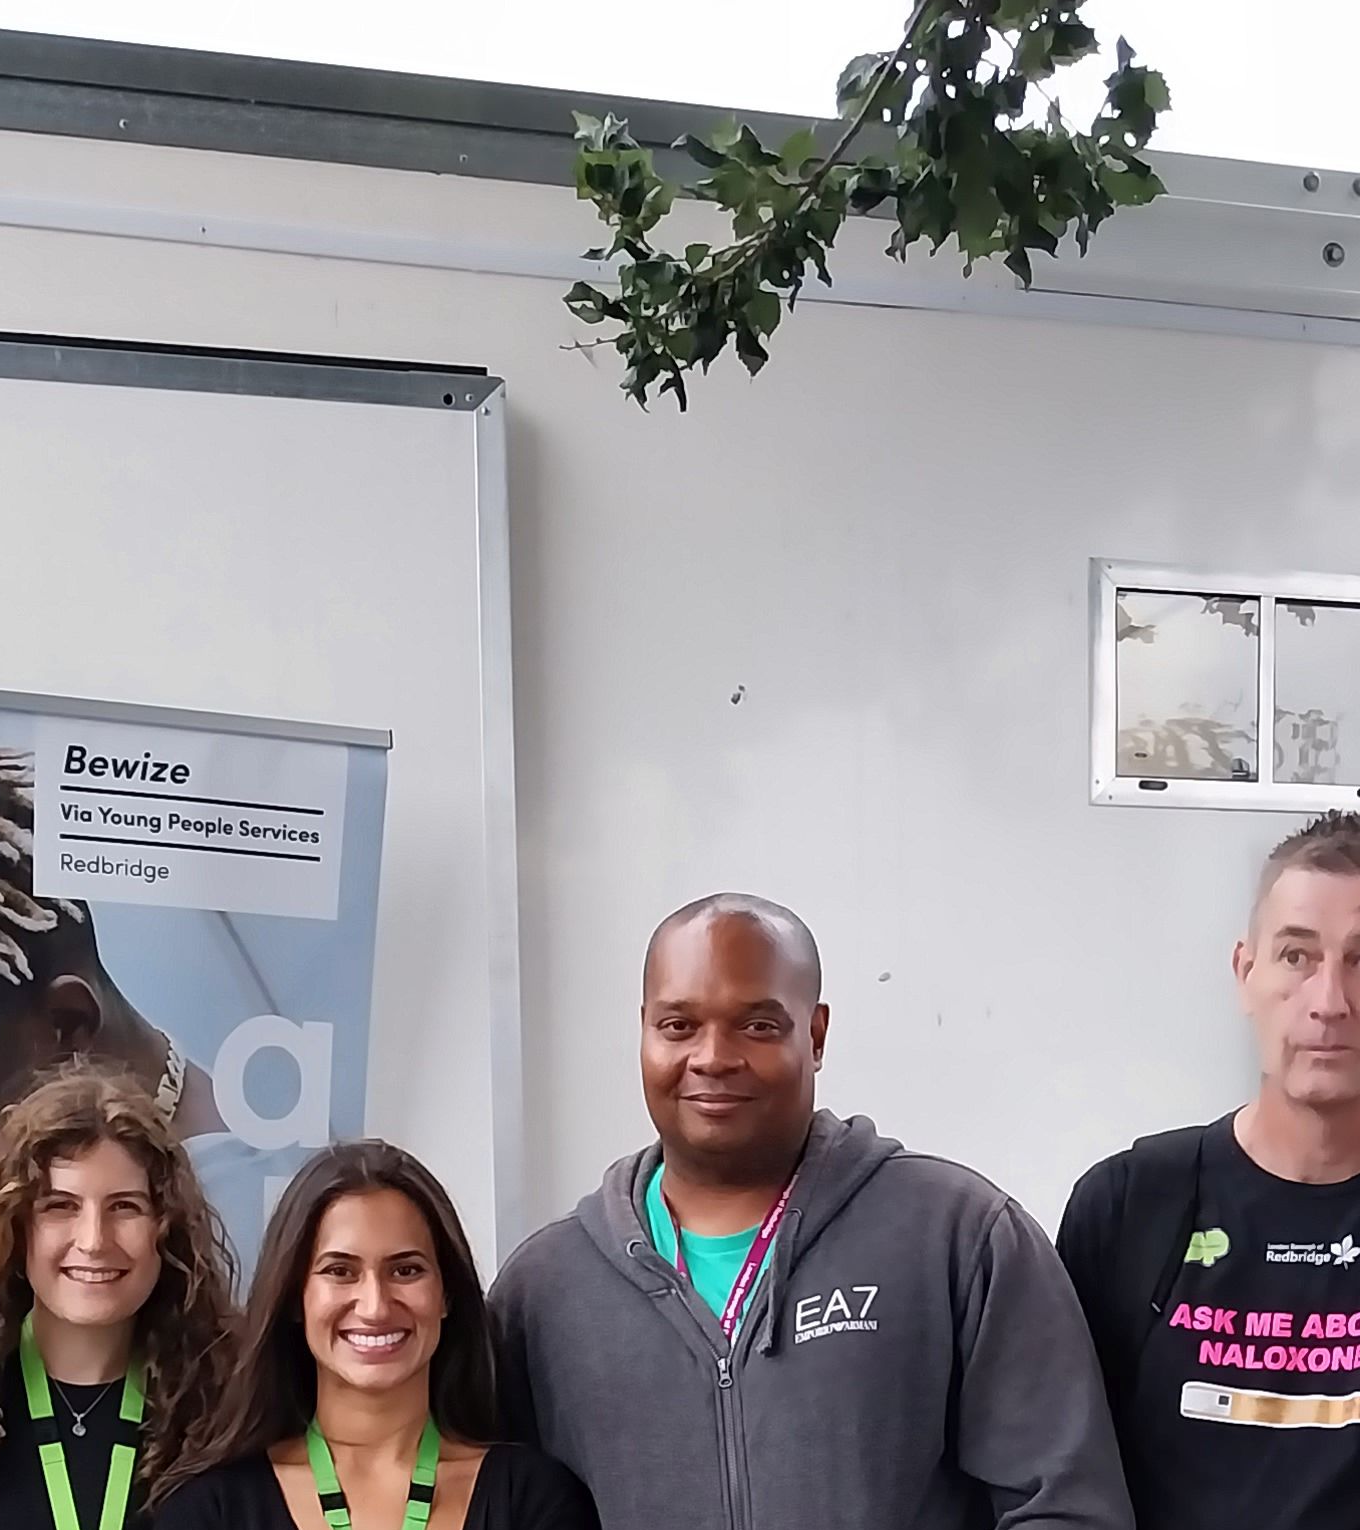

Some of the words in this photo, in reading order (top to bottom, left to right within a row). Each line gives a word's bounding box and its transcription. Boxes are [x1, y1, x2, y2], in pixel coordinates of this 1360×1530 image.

[64, 745, 190, 784] Bewize
[60, 803, 92, 823] Via
[98, 806, 161, 833] Young
[168, 813, 234, 838] People
[239, 820, 320, 844] Services
[60, 853, 170, 883] Redbridge
[1265, 1250, 1332, 1266] Redbridge
[795, 1286, 879, 1332] EA7
[1169, 1303, 1237, 1335] ASK
[1244, 1311, 1293, 1338] ME
